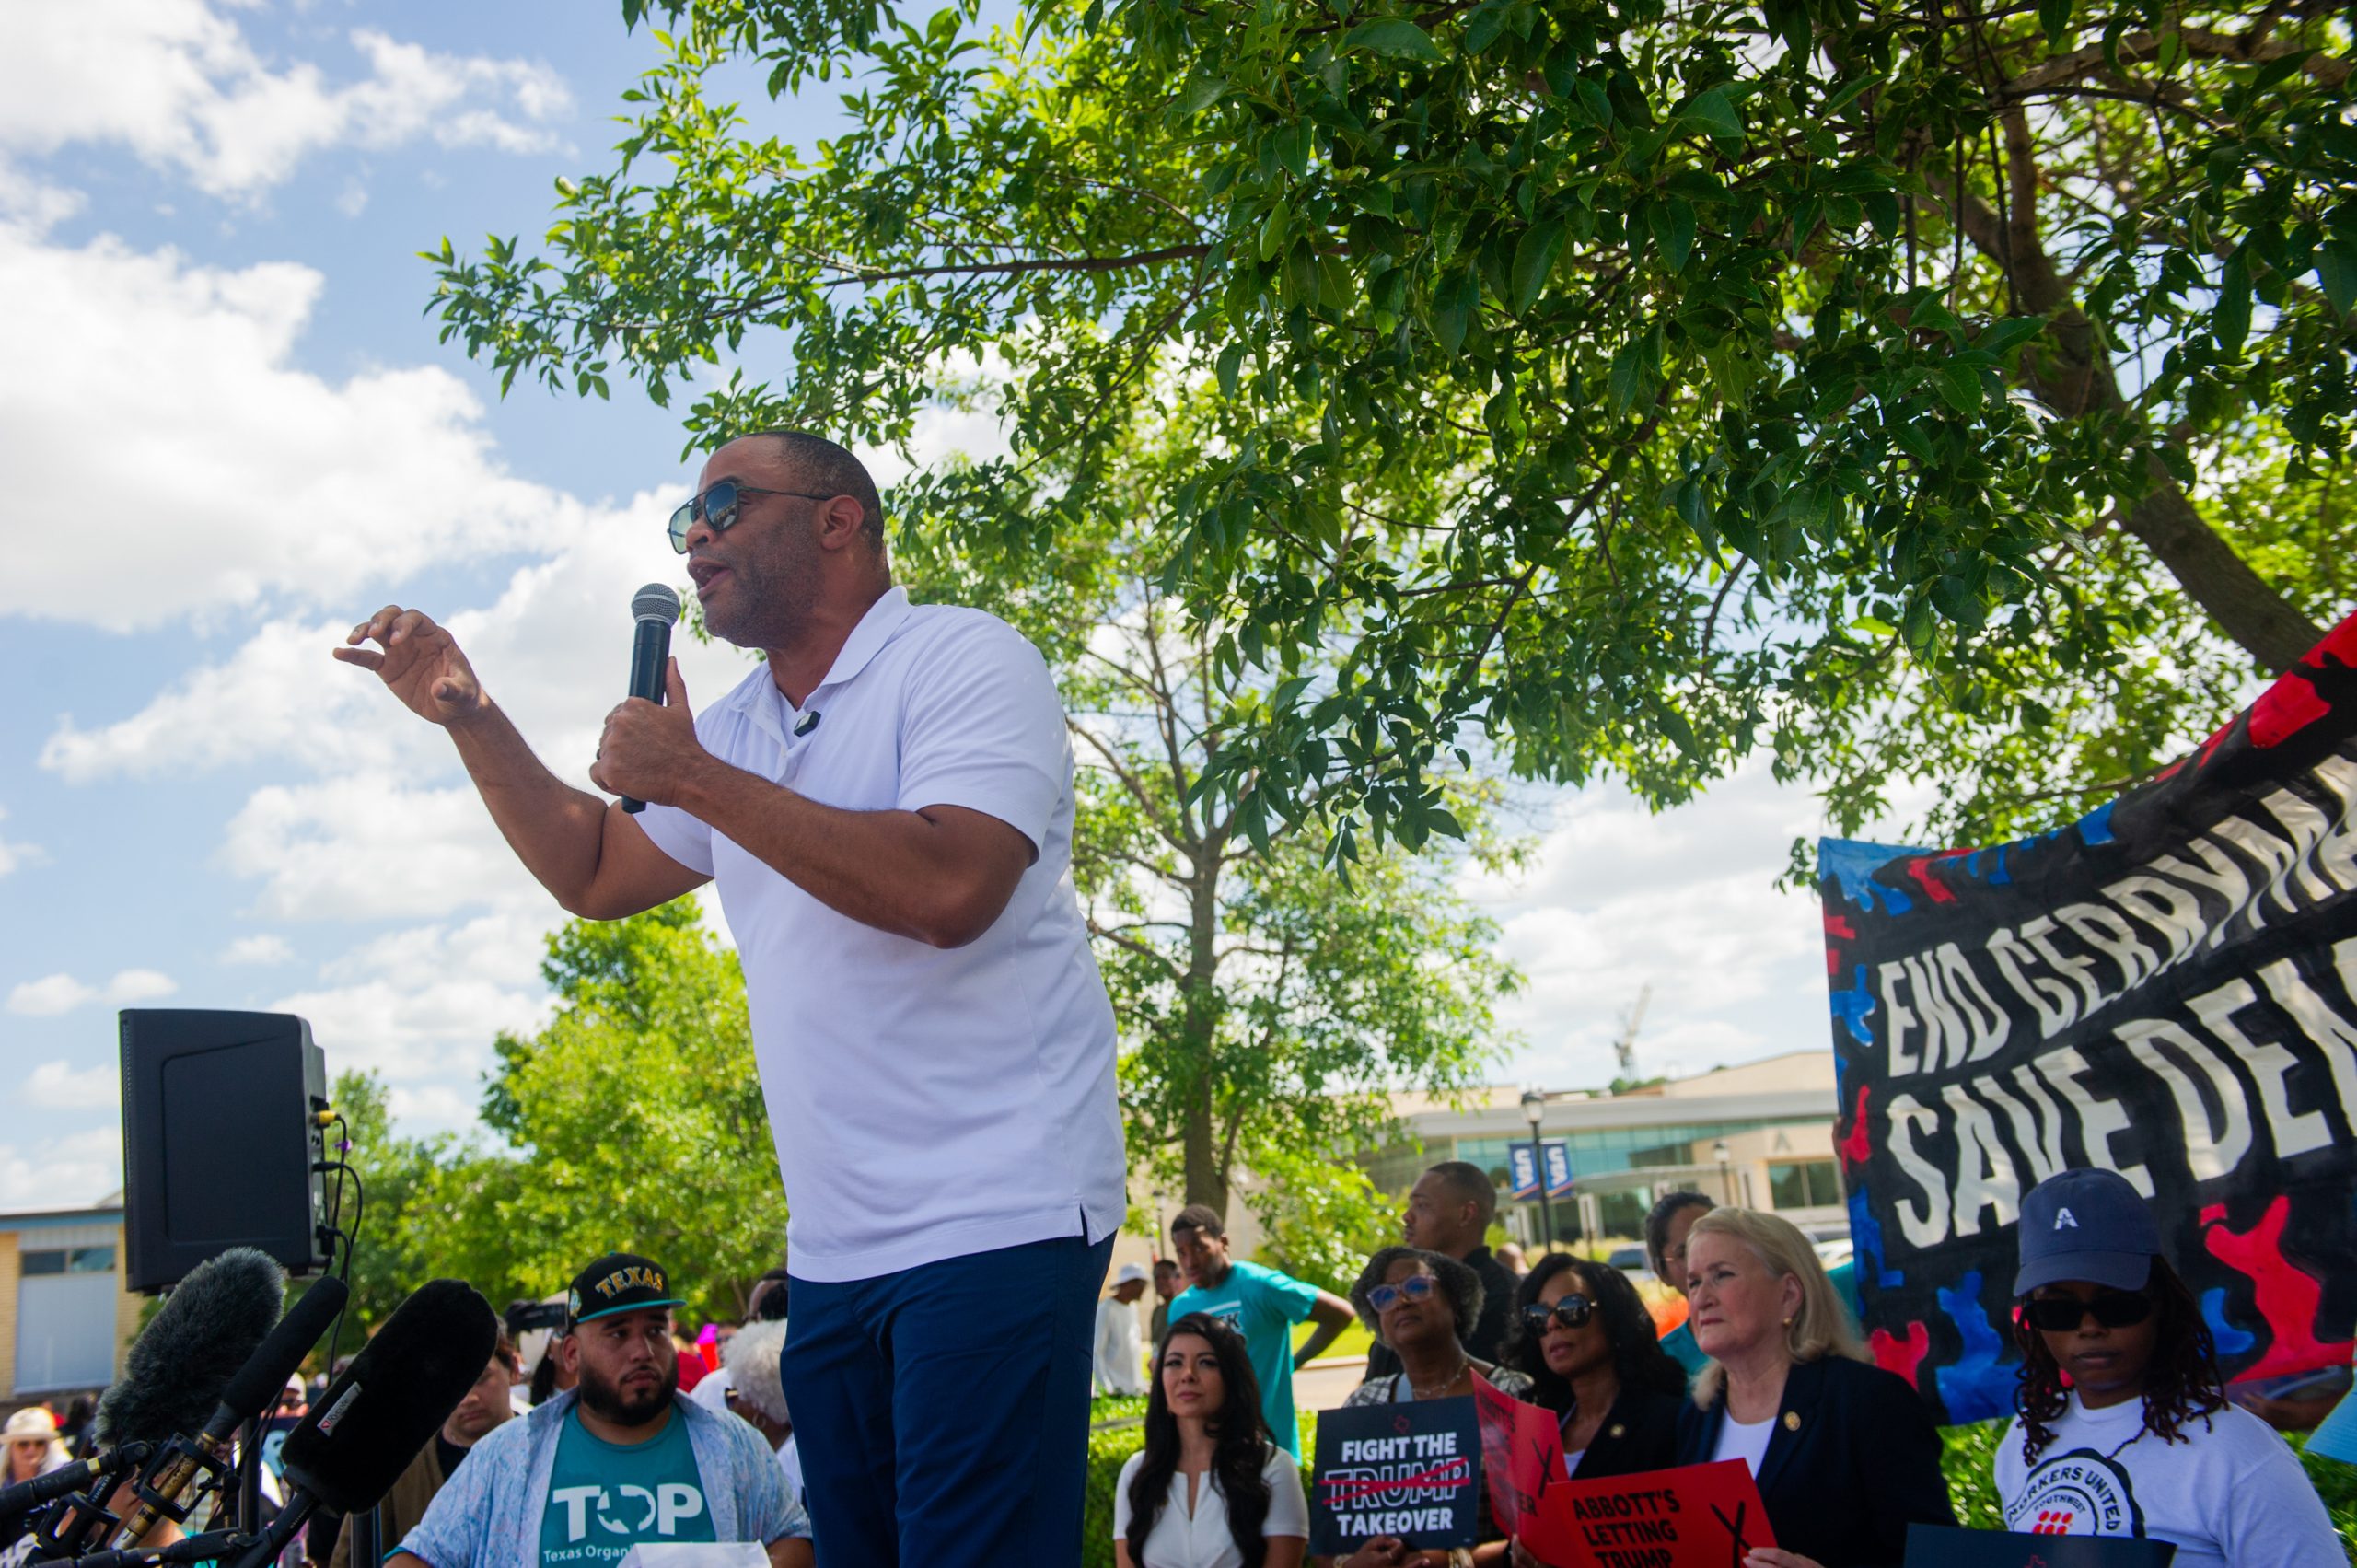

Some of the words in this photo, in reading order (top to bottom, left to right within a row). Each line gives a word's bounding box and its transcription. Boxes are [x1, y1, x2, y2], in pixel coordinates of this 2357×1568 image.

[1878, 941, 2012, 1077] END
[1886, 1045, 2155, 1249] SAVE
[2054, 1207, 2079, 1230] A
[595, 1266, 663, 1299] TEXAS
[1341, 1436, 1411, 1463] FIGHT
[1413, 1431, 1457, 1458] THE
[1324, 1457, 1470, 1511] TRUMP
[2084, 1470, 2121, 1531] UNITED
[552, 1482, 703, 1543] TOP
[1573, 1488, 1681, 1521] ABBOTT'S
[1336, 1507, 1454, 1537] TAKEOVER
[1582, 1520, 1678, 1547] LETTING
[543, 1545, 582, 1563] Texas
[1594, 1548, 1674, 1568] TRUMP
